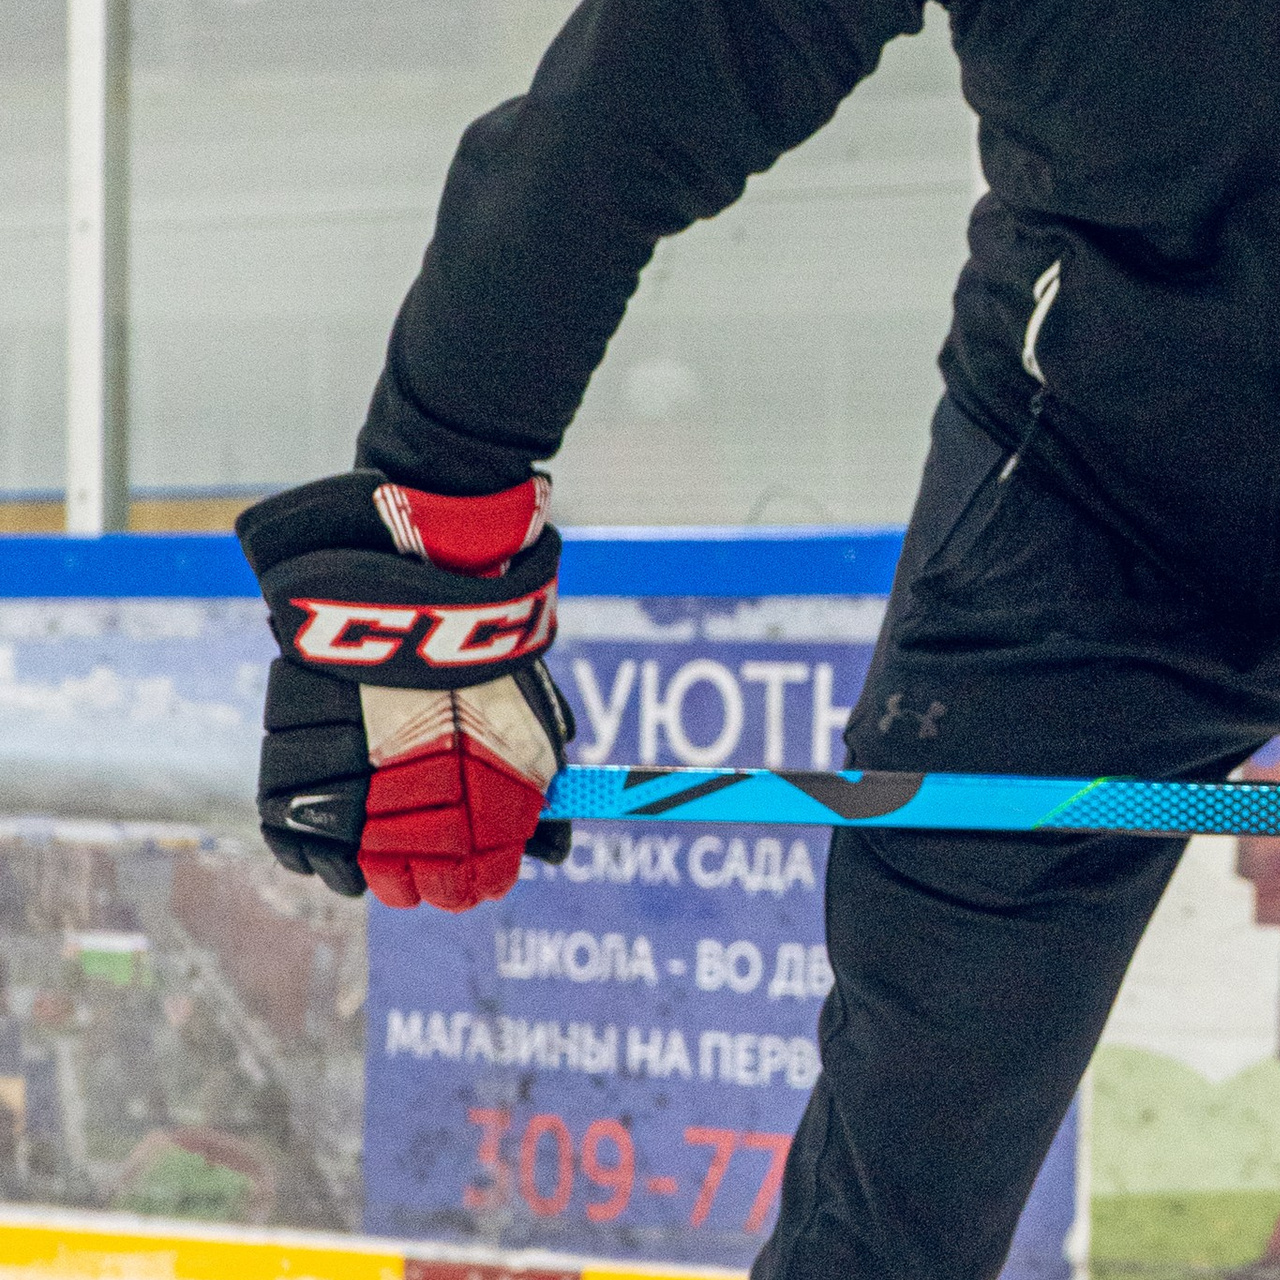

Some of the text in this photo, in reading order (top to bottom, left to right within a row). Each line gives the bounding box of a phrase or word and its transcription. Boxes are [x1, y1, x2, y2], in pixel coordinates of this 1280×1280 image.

[687, 835, 815, 897] САДА
[498, 928, 659, 985] ШКОЛА
[696, 938, 763, 994] ВО
[384, 1008, 618, 1074] МАГАЗИНЫ
[626, 1023, 692, 1080] НА
